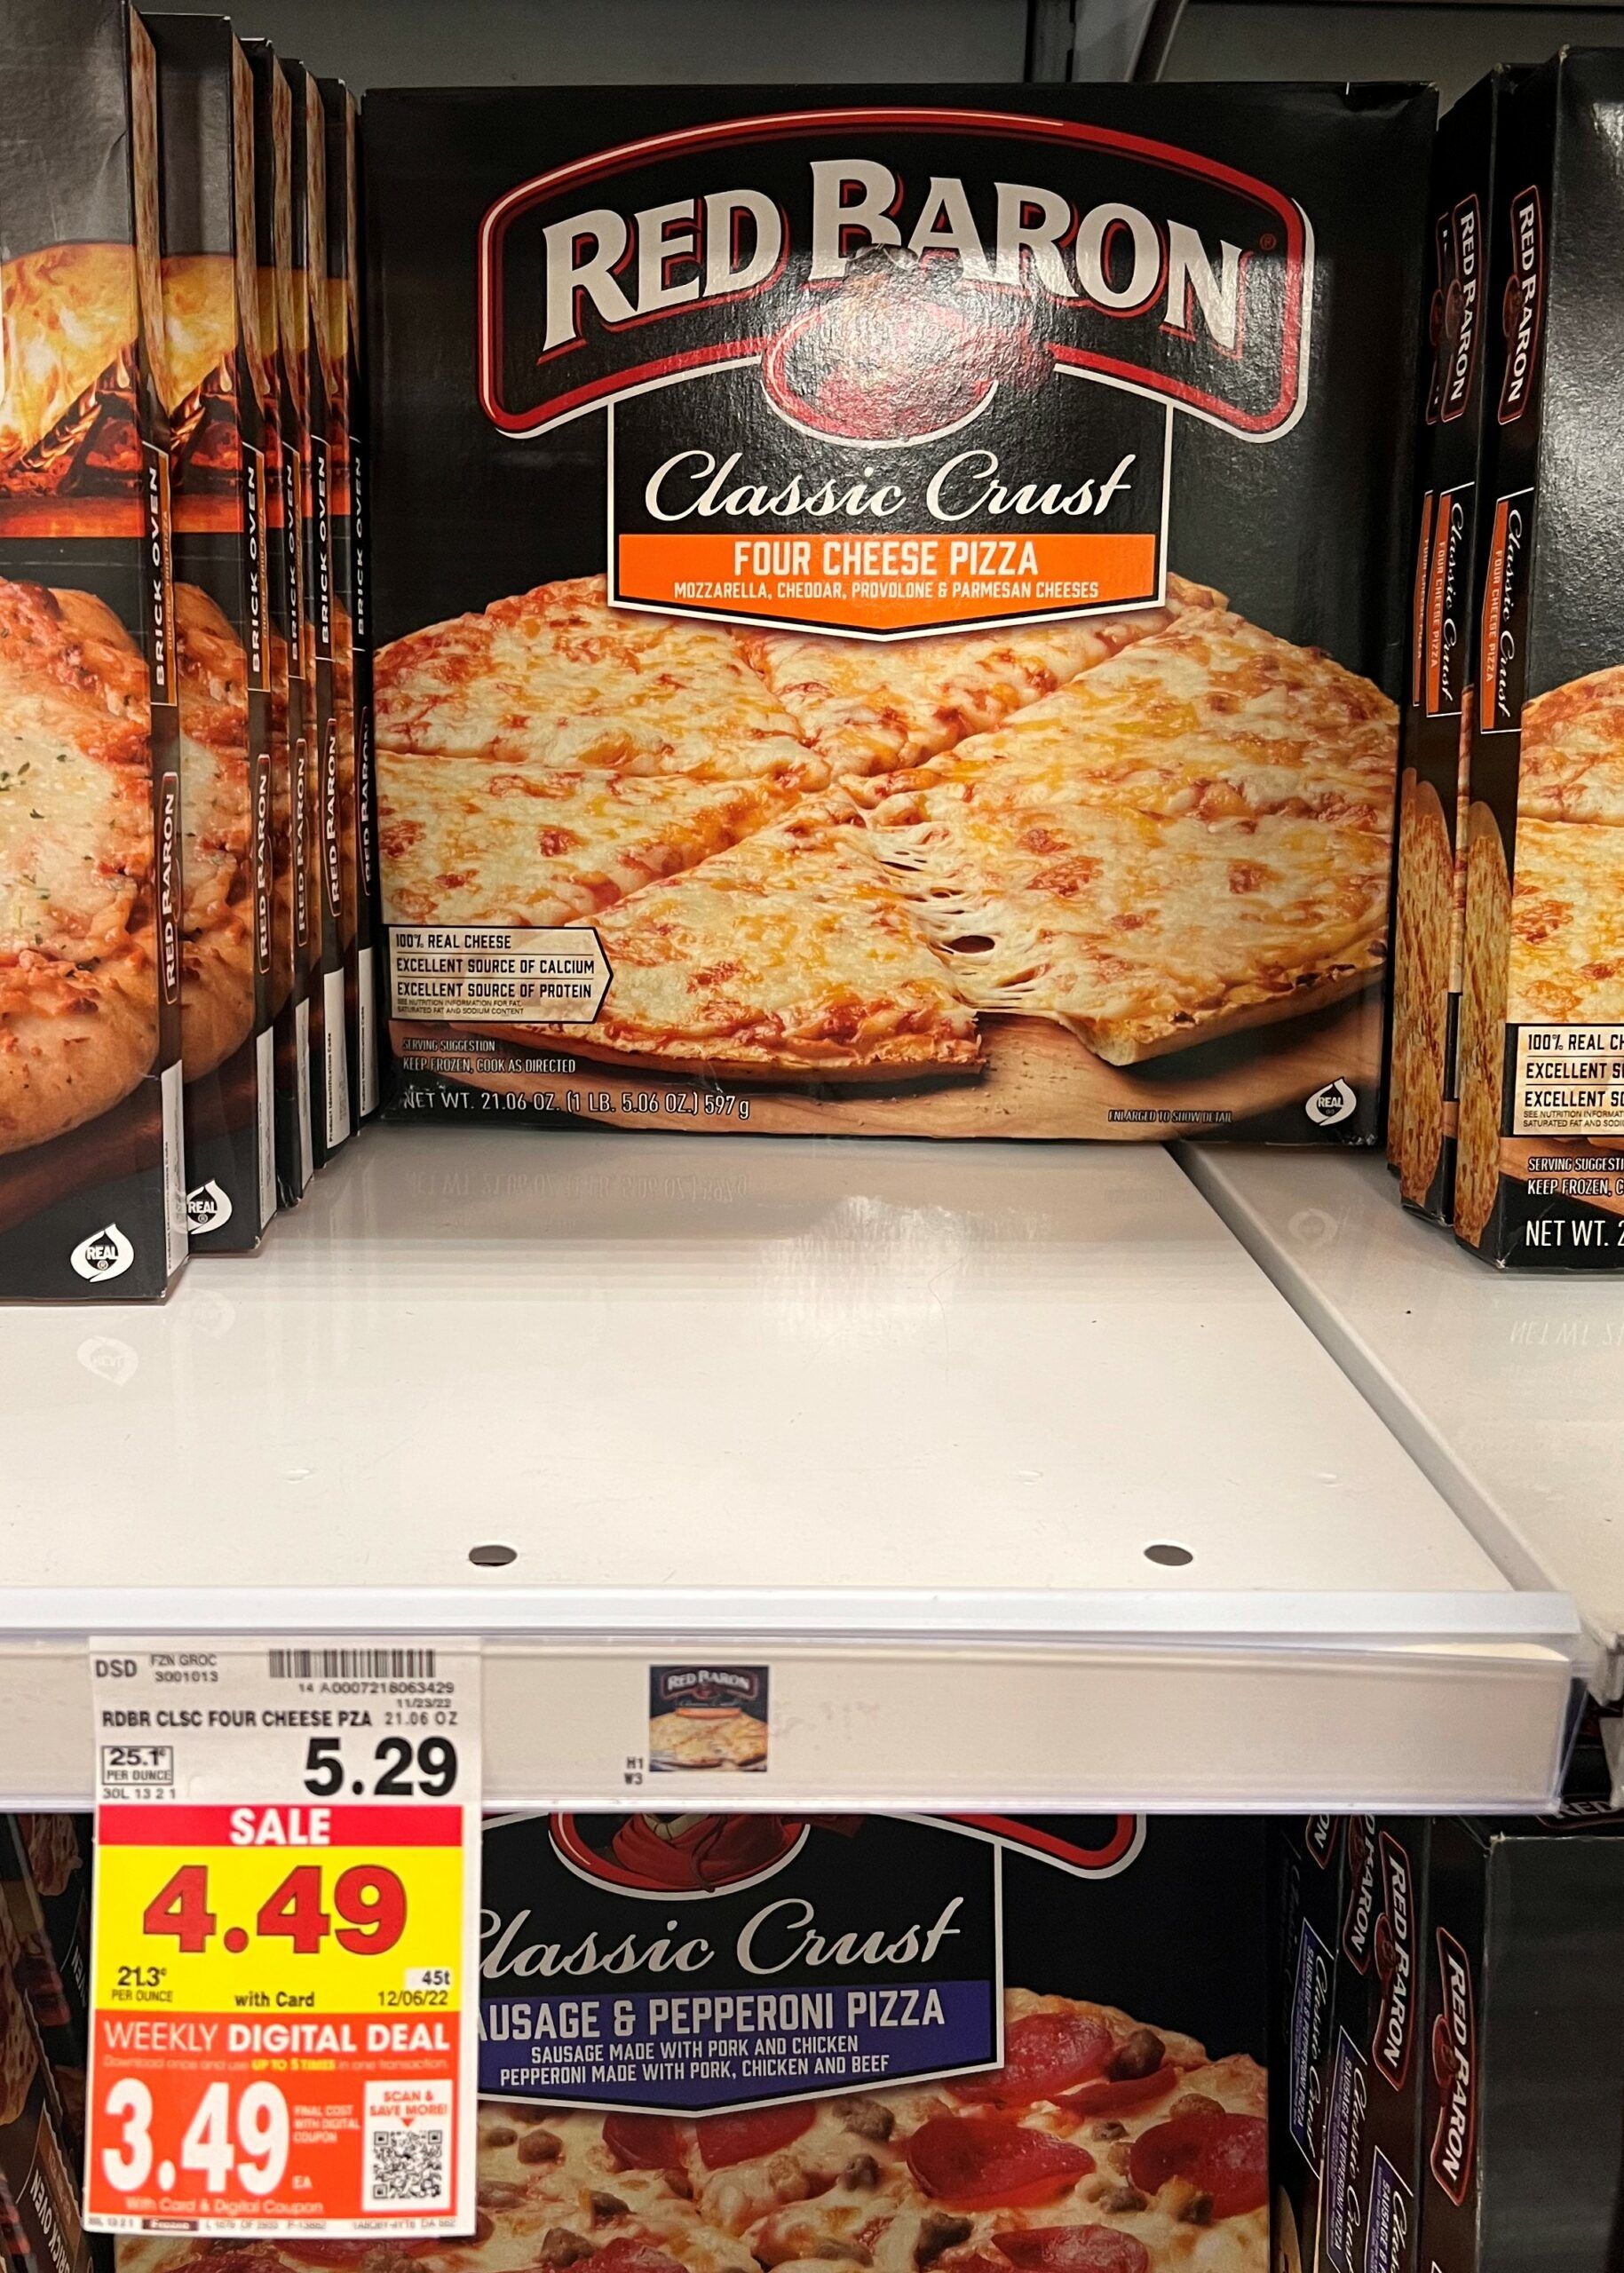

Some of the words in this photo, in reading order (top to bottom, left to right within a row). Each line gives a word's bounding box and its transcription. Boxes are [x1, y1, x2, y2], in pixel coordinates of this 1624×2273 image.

[1461, 211, 1476, 275] RED
[1519, 202, 1534, 271] RED
[542, 187, 782, 352] RED
[806, 159, 1243, 351] BARON
[1451, 279, 1476, 400] BARON
[1508, 274, 1536, 403] BARON
[645, 449, 906, 521] Classic
[926, 449, 1137, 521] Crust
[149, 467, 160, 566] OVEN
[248, 467, 257, 560] OVEN
[287, 465, 296, 554] OVEN
[734, 541, 813, 576] FOUR
[823, 541, 939, 576] CHEESE
[950, 541, 1038, 576] PIZZA
[1446, 503, 1463, 610] Classic
[1502, 510, 1522, 622] Classic
[674, 582, 772, 600] MOZZARELLA,
[776, 582, 847, 600] CHEDDAR,
[852, 582, 933, 598] PROVOLONE
[939, 582, 947, 598] &
[953, 582, 1032, 598] PARMESAN
[1035, 582, 1099, 598] CHEESES
[154, 579, 164, 685] BRICK
[1442, 618, 1457, 701] Crust
[1485, 642, 1497, 681] PIZZA
[1498, 630, 1515, 717] Crust
[327, 736, 336, 839] BARON
[257, 775, 266, 888] BARON
[162, 793, 174, 915] BARON
[329, 849, 339, 902] RED
[166, 922, 175, 988] RED
[396, 933, 424, 950] 100%
[428, 934, 460, 949] REAL
[464, 934, 511, 949] CHEESE
[397, 958, 463, 974] EXCELLENT
[468, 958, 515, 974] SOURCE
[519, 958, 535, 974] OF
[540, 959, 594, 974] CALCIUM
[397, 982, 463, 998] EXCELLENT
[468, 982, 516, 998] SOURCE
[520, 982, 535, 998] OF
[540, 982, 591, 998] PROTEIN
[403, 1039, 438, 1051] SERVING
[440, 1040, 495, 1051] SUGGESTION
[1528, 1034, 1563, 1050] 100%
[1568, 1034, 1604, 1050] REAL
[403, 1057, 429, 1072] KEEP
[431, 1057, 473, 1073] FROZEN,
[477, 1058, 503, 1073] COOK
[505, 1058, 521, 1073] AS
[526, 1058, 575, 1073] DIRECTED
[1526, 1063, 1607, 1078] EXCELLENT
[403, 1091, 434, 1109] NET
[441, 1092, 474, 1110] WT.
[481, 1093, 527, 1110] 21.06
[534, 1093, 559, 1111] OZ.
[590, 1093, 615, 1112] LB.
[622, 1094, 658, 1112] 5.06
[665, 1092, 698, 1114] OZ.)
[705, 1095, 736, 1115] 597
[1318, 1097, 1343, 1108] REAL
[1525, 1091, 1605, 1107] EXCELLENT
[1108, 1110, 1155, 1122] ENLARGED
[1157, 1111, 1169, 1122] TO
[1171, 1111, 1200, 1122] SHOW
[1202, 1112, 1232, 1123] DETAIL
[1528, 1158, 1573, 1172] SERVING
[1527, 1179, 1558, 1194] KEEP
[1562, 1179, 1612, 1196] FROZEN,
[188, 1201, 218, 1214] REAL
[1525, 1220, 1565, 1247] NET
[1572, 1220, 1609, 1247] WT.
[86, 1246, 118, 1260] REAL
[97, 1659, 138, 1678] DSD
[150, 1654, 177, 1667] FZN
[180, 1654, 217, 1667] GROC
[154, 1671, 218, 1683] 3001013
[668, 1672, 697, 1691] RED
[698, 1670, 749, 1690] BARON
[298, 1683, 313, 1692] 14
[103, 1711, 151, 1727] RDBR
[156, 1711, 203, 1727] CLSC
[209, 1711, 256, 1727] FOUR
[262, 1711, 332, 1727] CHEESE
[338, 1711, 372, 1727] PZA
[385, 1712, 429, 1725] 21.06
[436, 1712, 457, 1725] OZ
[107, 1770, 129, 1781] PER
[133, 1770, 171, 1781] OUNCE
[304, 1737, 457, 1796] 5.29
[626, 1757, 644, 1770] H1
[230, 1808, 331, 1845] SALE
[143, 1864, 408, 1955] 4.49
[1389, 1855, 1407, 1937] RED
[737, 1897, 963, 1975] Crust
[112, 1990, 132, 2001] PER
[136, 1990, 172, 2003] OUNCE
[234, 1992, 271, 2008] with
[276, 1992, 315, 2008] Card
[378, 1991, 448, 2007] 12/06/22
[614, 2000, 636, 2037] &
[650, 1993, 834, 2034] PEPPERONI
[849, 1988, 945, 2028] PIZZA
[1383, 1939, 1409, 2068] BARON
[1446, 1954, 1466, 2045] RED
[104, 2021, 218, 2052] WEEKLY
[228, 2024, 356, 2052] DIGITAL
[368, 2024, 450, 2052] DEAL
[531, 2044, 603, 2063] SAUSAGE
[609, 2043, 655, 2061] MADE
[661, 2041, 702, 2059] WITH
[709, 2039, 749, 2057] PORK
[754, 2038, 786, 2056] AND
[792, 2035, 858, 2054] CHICKEN
[500, 2067, 586, 2086] PEPPERONI
[591, 2064, 638, 2082] MADE
[642, 2063, 684, 2081] WITH
[690, 2061, 736, 2080] PORK,
[742, 2057, 807, 2077] CHICKEN
[812, 2056, 845, 2075] AND
[852, 2055, 889, 2073] BEEF
[294, 2105, 322, 2116] FINAL
[384, 2091, 420, 2102] SCAN
[369, 2105, 400, 2117] SAVE
[406, 2104, 448, 2116] MORE!
[1442, 2045, 1469, 2181] BARON
[102, 2078, 289, 2195] 3.49
[293, 2131, 337, 2143] COUPON
[295, 2118, 321, 2129] WITH
[321, 2119, 360, 2129] DIGITAL
[292, 2175, 312, 2190] EA
[30, 2168, 51, 2234] OVEN
[125, 2199, 154, 2211] With
[160, 2199, 195, 2212] Card
[214, 2199, 258, 2214] Digital
[264, 2200, 323, 2214] Coupon
[1378, 2179, 1390, 2250] SAUSAGE
